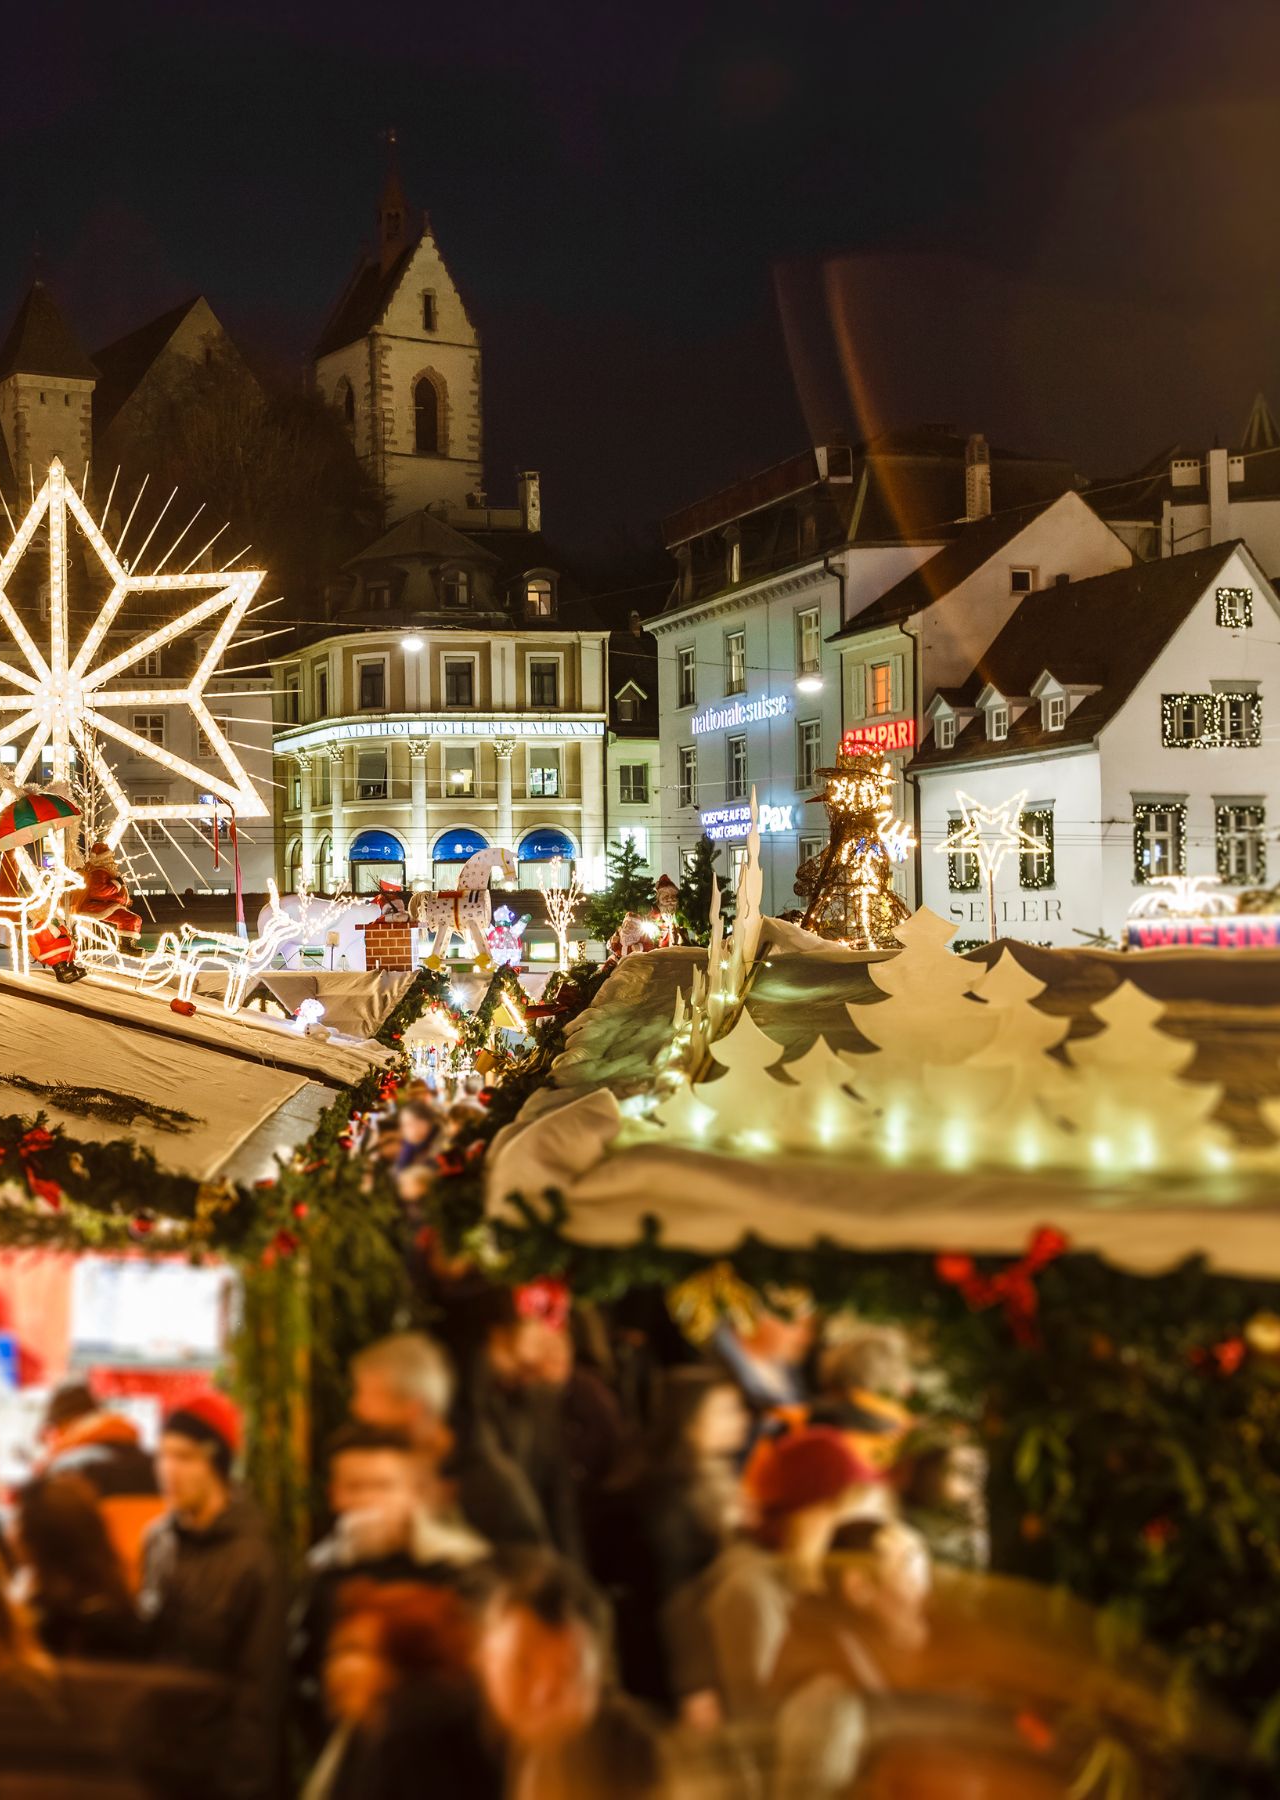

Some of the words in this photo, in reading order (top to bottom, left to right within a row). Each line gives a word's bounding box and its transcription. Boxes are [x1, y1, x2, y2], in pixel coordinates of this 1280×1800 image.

[692, 694, 787, 735] nationalesuisse
[425, 722, 480, 734] HOTEL
[488, 722, 601, 734] RESTAURANT
[949, 899, 1063, 922] SELER
